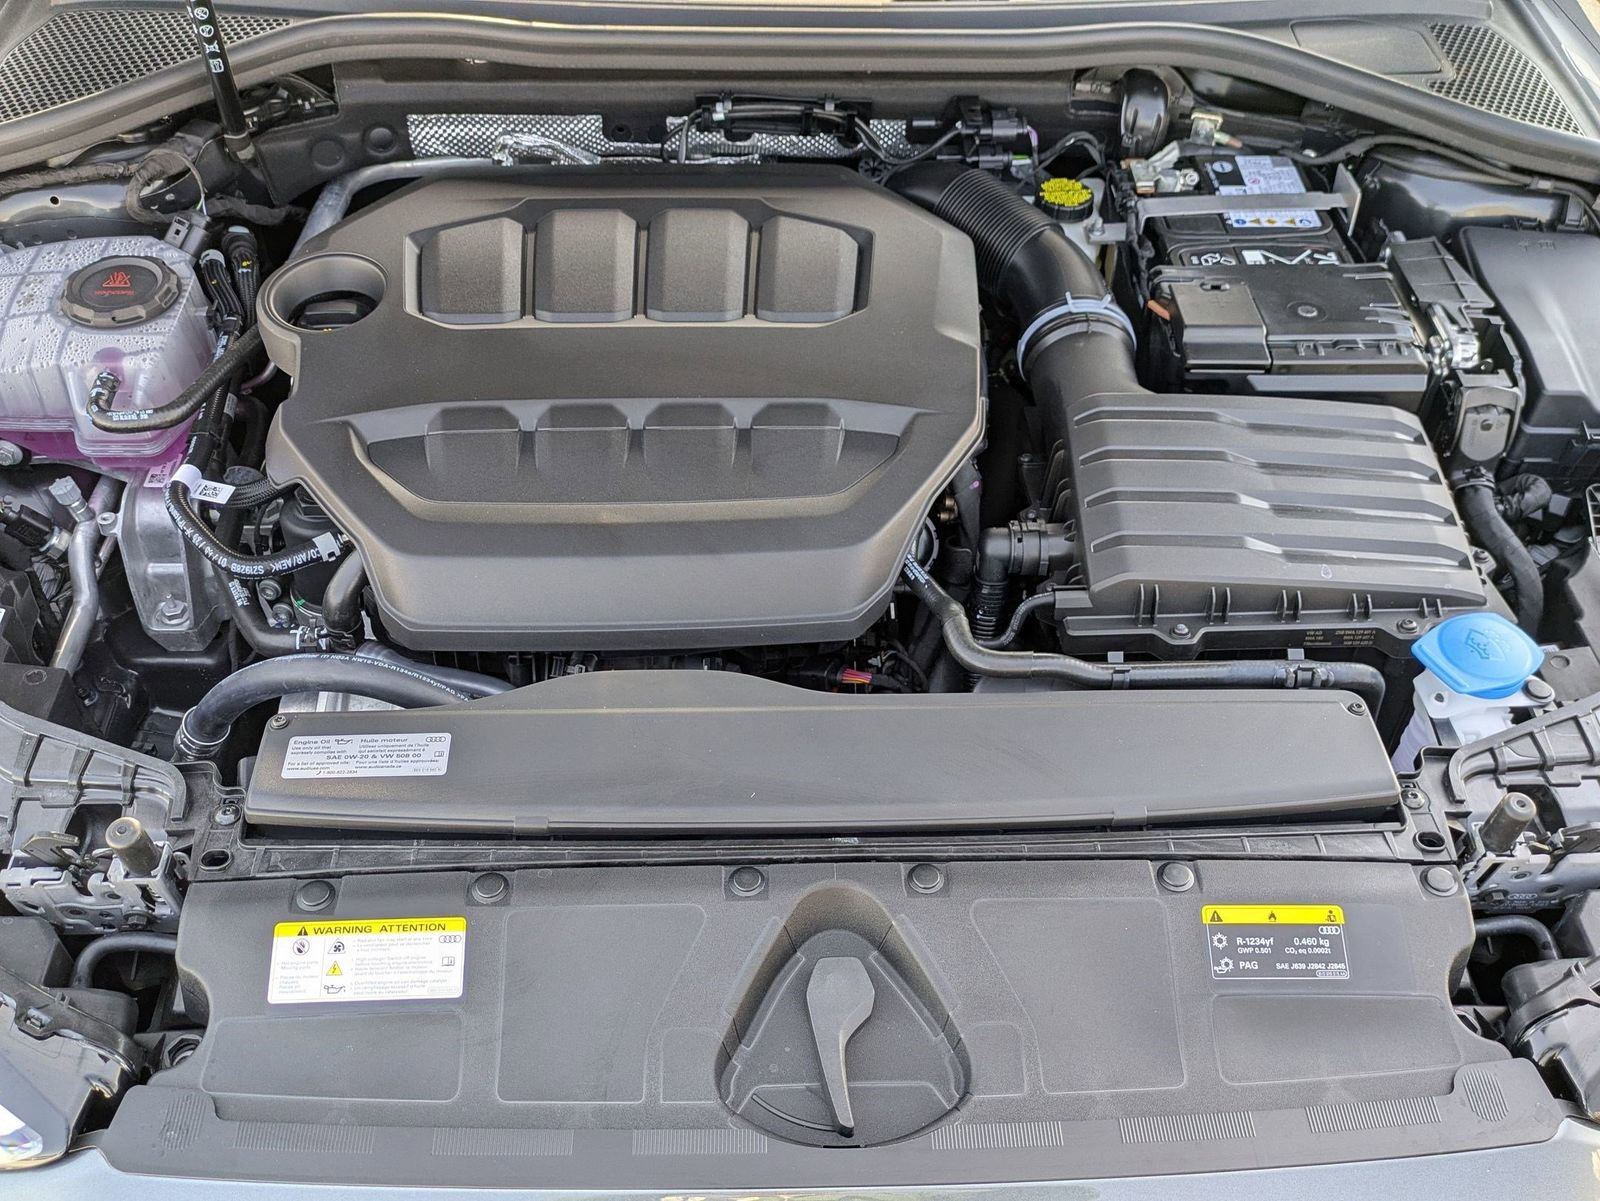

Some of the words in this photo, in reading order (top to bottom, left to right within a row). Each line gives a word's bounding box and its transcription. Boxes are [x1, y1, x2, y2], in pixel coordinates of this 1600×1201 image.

[313, 925, 373, 935] WARNING
[379, 923, 446, 932] ATTENTION
[1236, 937, 1274, 947] R-1234yf
[1293, 937, 1318, 946] 0.460
[1319, 937, 1330, 947] kg
[1239, 961, 1259, 970] PAG
